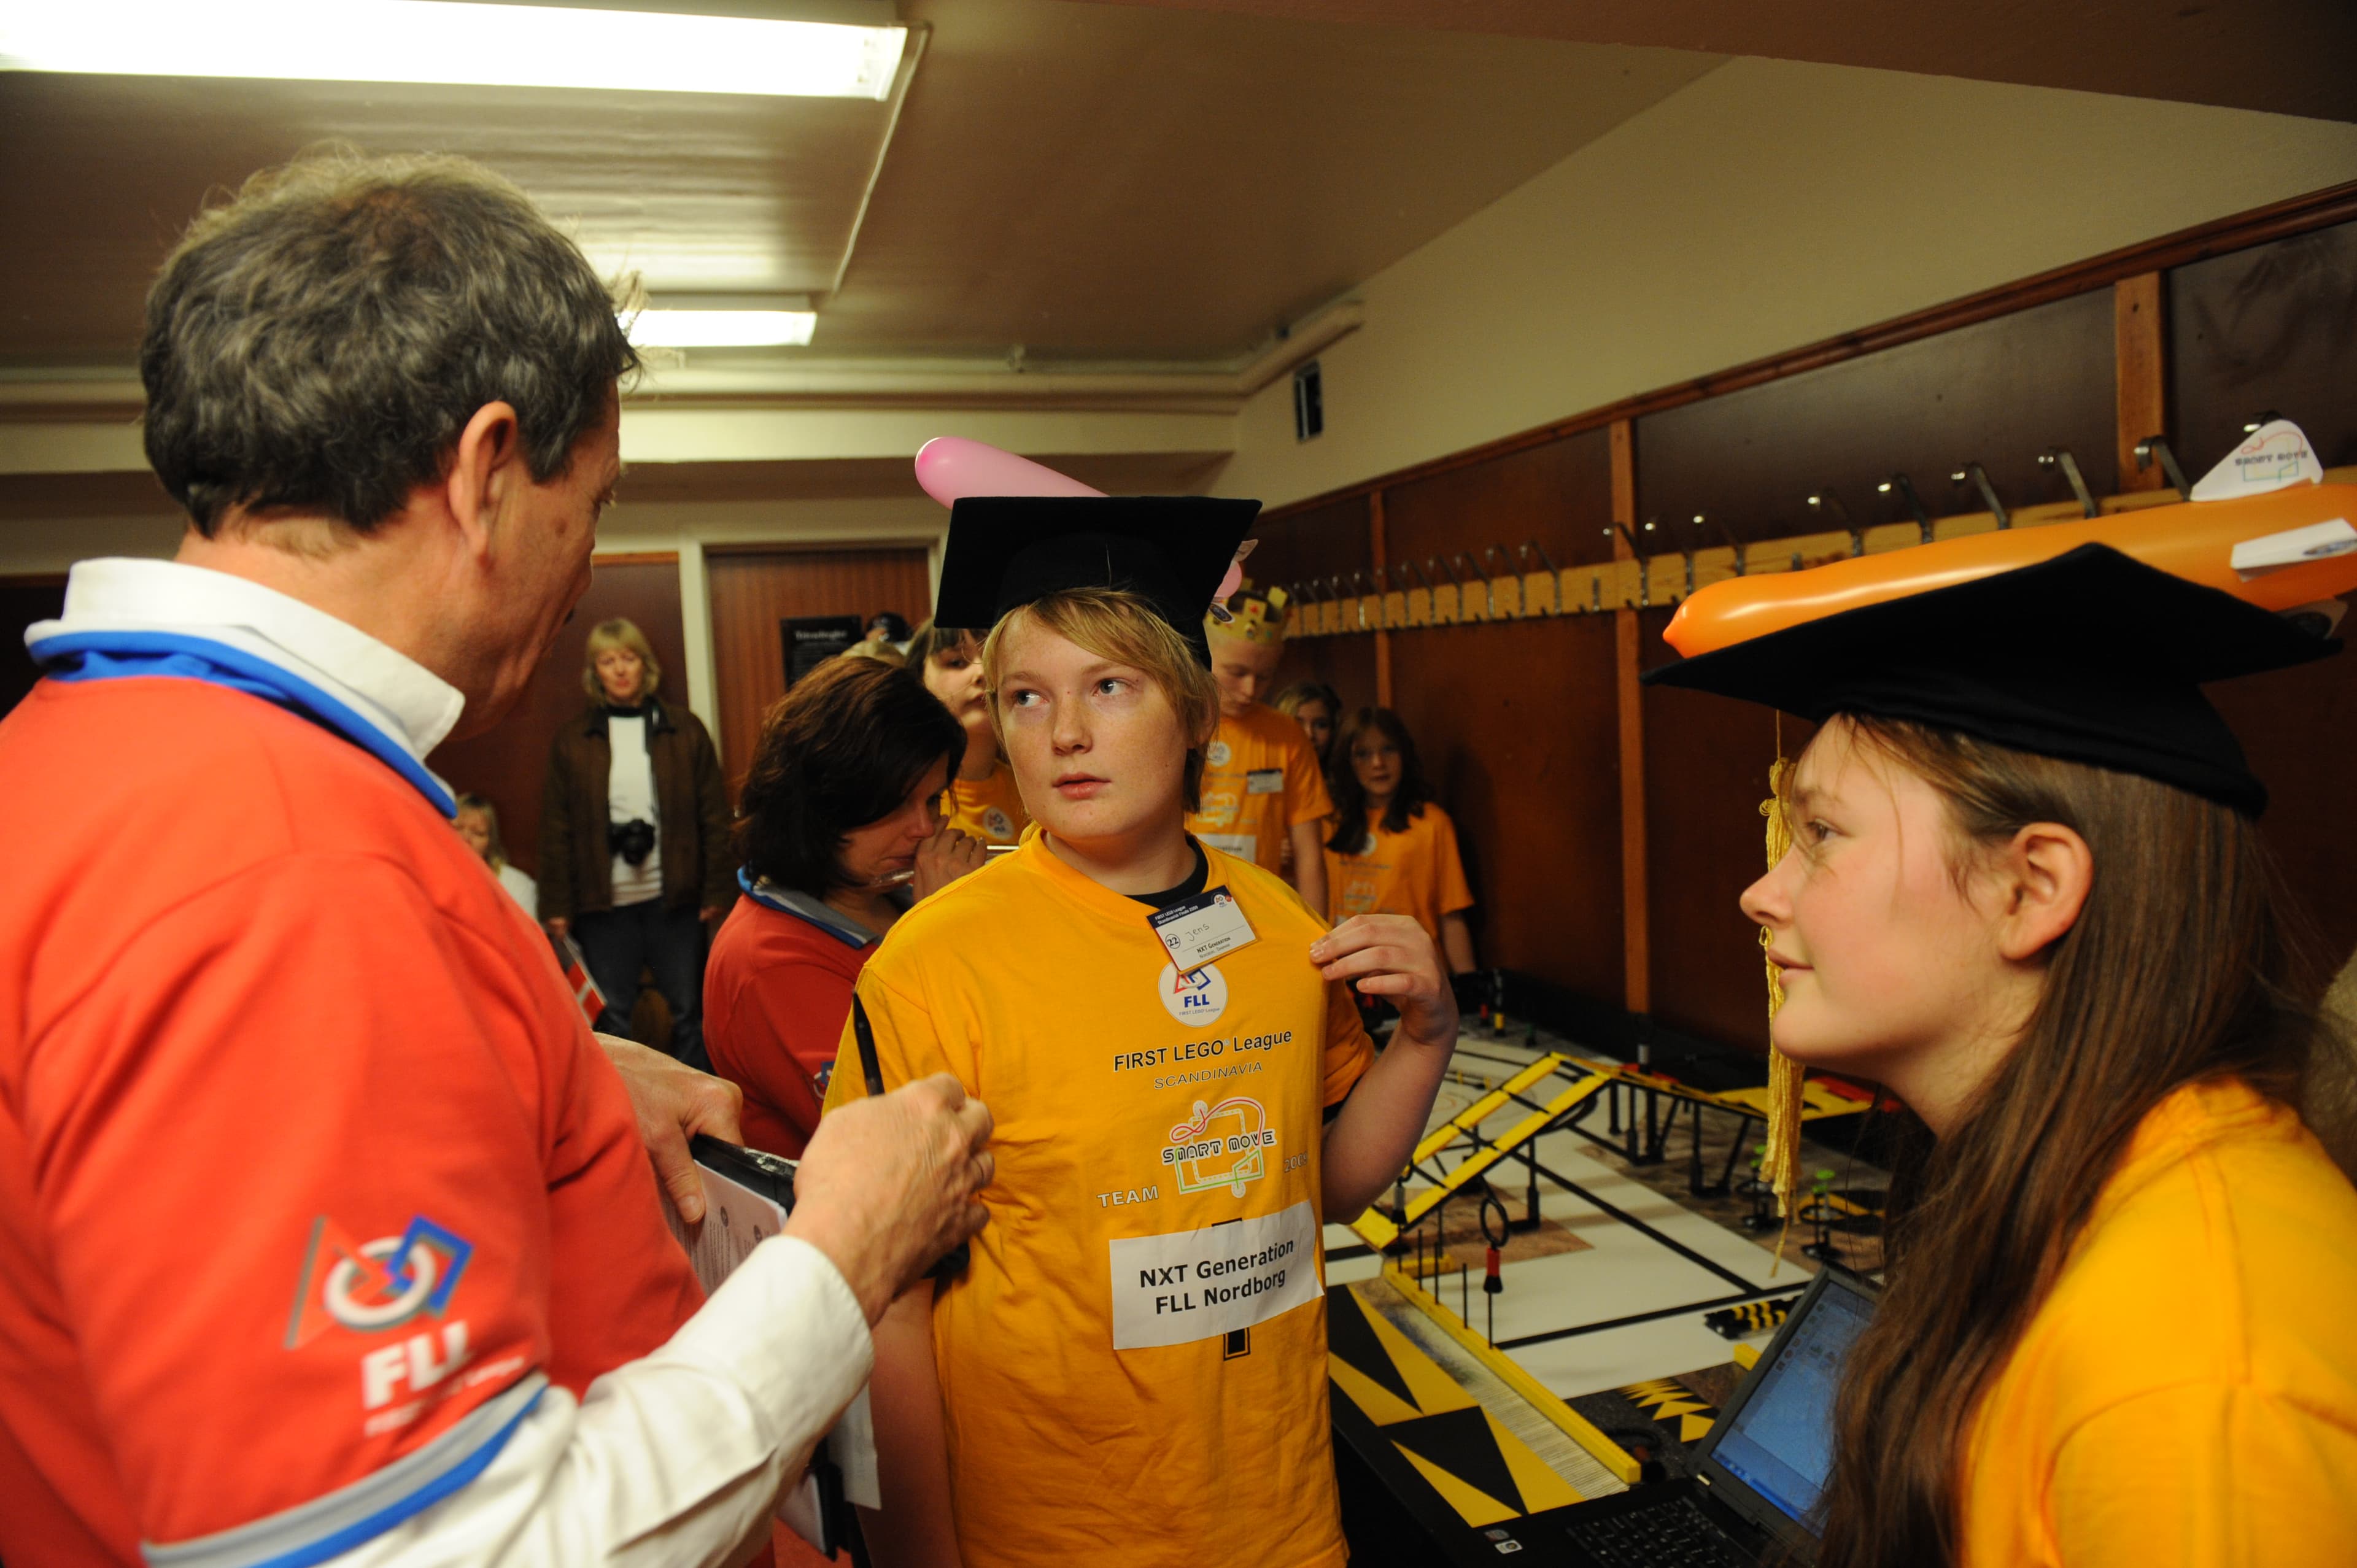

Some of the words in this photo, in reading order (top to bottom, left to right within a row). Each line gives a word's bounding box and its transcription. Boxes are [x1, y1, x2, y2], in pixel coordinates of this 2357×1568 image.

[1167, 937, 1179, 947] 22
[1196, 944, 1207, 953] NXT
[1184, 994, 1210, 1008] FLL
[1114, 1047, 1167, 1072] FIRST
[1233, 1030, 1292, 1053] League
[1154, 1062, 1263, 1089] SCANDINAVIA
[1162, 1140, 1221, 1164] SMART
[1228, 1130, 1275, 1152] MOVE
[1097, 1185, 1159, 1208] TEAM
[1140, 1264, 1188, 1288] NXT
[1196, 1239, 1294, 1280] Generation
[1156, 1292, 1196, 1315] FLL
[1204, 1269, 1286, 1307] Nordborg
